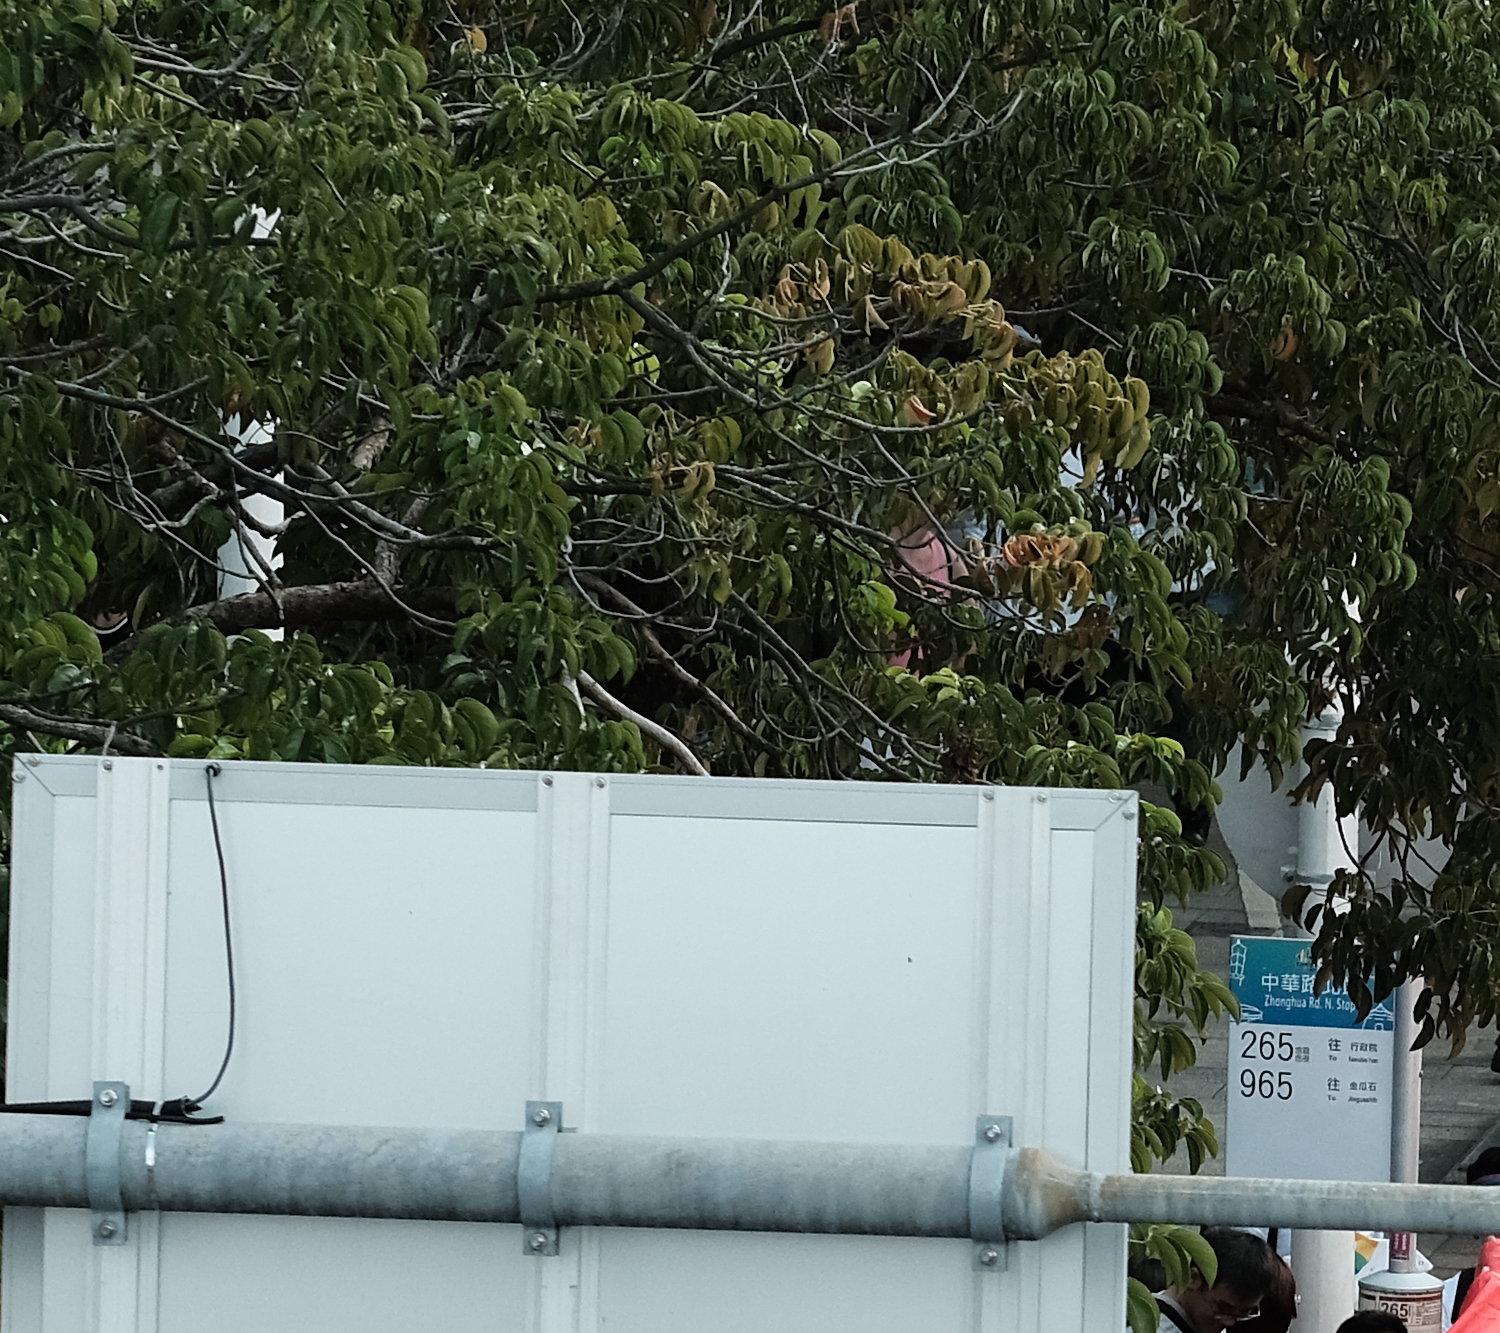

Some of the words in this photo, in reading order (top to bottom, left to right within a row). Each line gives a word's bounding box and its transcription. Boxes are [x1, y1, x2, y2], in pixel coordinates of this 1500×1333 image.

[1264, 994, 1307, 1011] Zhonghua
[1240, 1030, 1294, 1061] 265
[1327, 1037, 1342, 1052] 往
[1240, 1068, 1293, 1101] 965
[1327, 1077, 1341, 1092] 往
